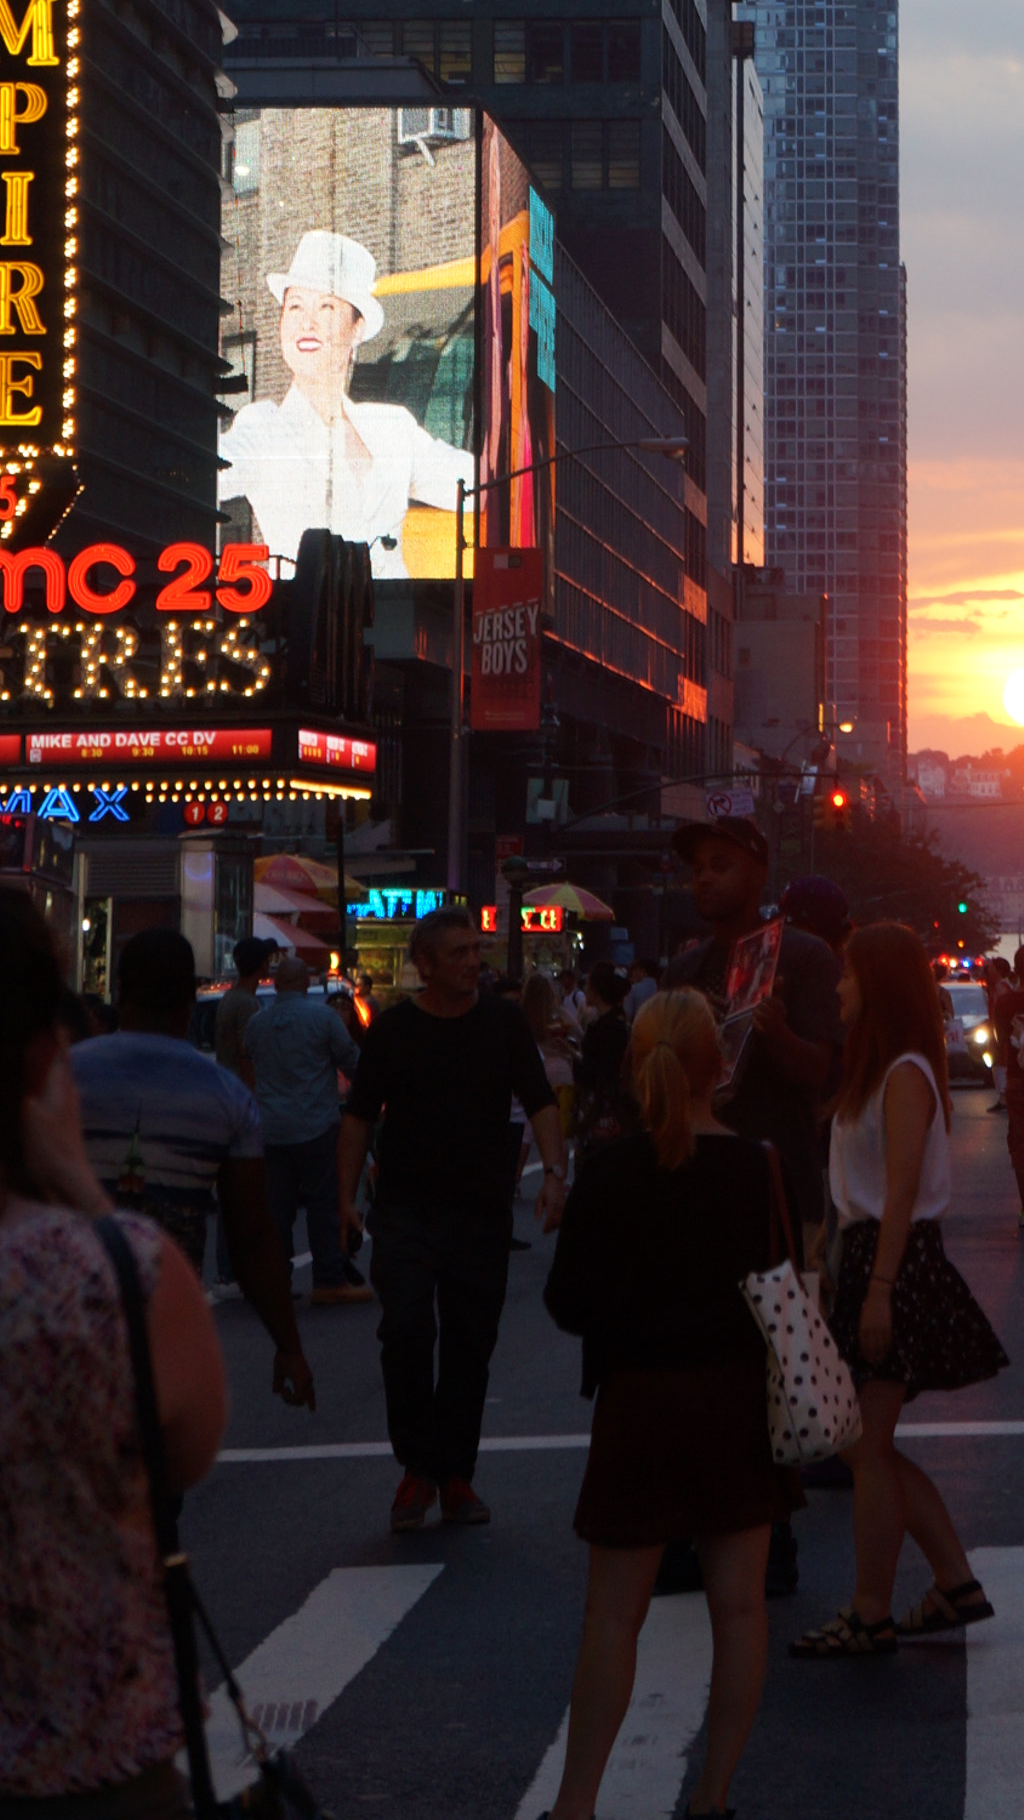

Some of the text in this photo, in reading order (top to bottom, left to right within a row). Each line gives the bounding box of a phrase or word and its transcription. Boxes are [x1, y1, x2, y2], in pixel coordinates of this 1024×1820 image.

[156, 542, 273, 613] 25
[473, 602, 540, 644] JERSEY
[0, 618, 271, 707] TRES
[481, 639, 528, 675] BOYS
[31, 731, 217, 748] MIKE AND DAVE CC DV
[132, 747, 154, 758] 9:30
[182, 746, 208, 757] 10:15
[232, 745, 260, 756] 11:00
